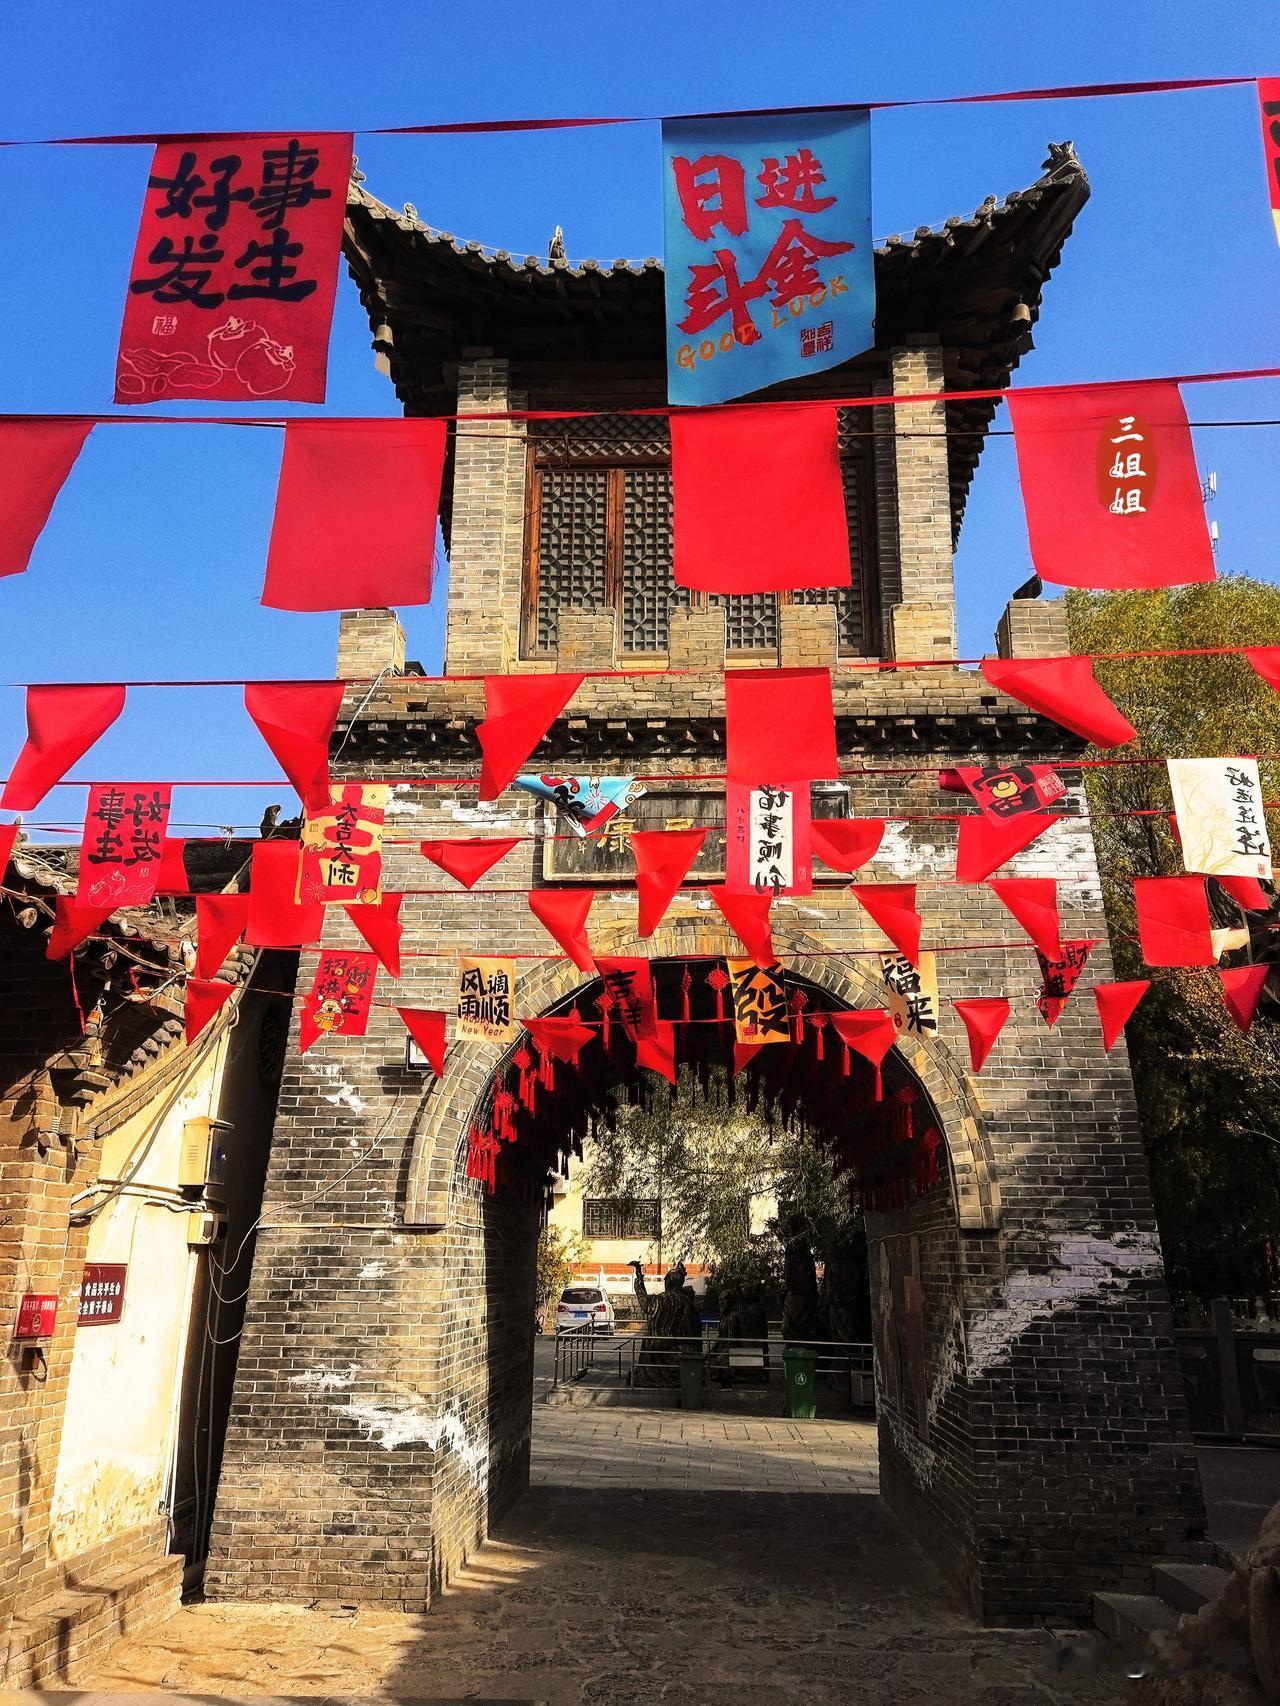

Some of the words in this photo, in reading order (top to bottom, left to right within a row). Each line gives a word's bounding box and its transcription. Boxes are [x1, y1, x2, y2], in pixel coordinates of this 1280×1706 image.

[148, 139, 331, 231] 好事
[671, 149, 837, 241] 日进
[130, 228, 317, 309] 发生
[676, 219, 854, 345] 斗金
[153, 316, 177, 335] 福
[676, 322, 757, 370] GOOD
[771, 275, 849, 329] LOOK
[1109, 416, 1147, 514] 三姐姐
[457, 995, 510, 1027] 雨顺
[460, 967, 509, 996] 风调
[463, 1013, 491, 1026] Happy
[461, 1025, 480, 1035] New
[483, 1025, 505, 1036] Year
